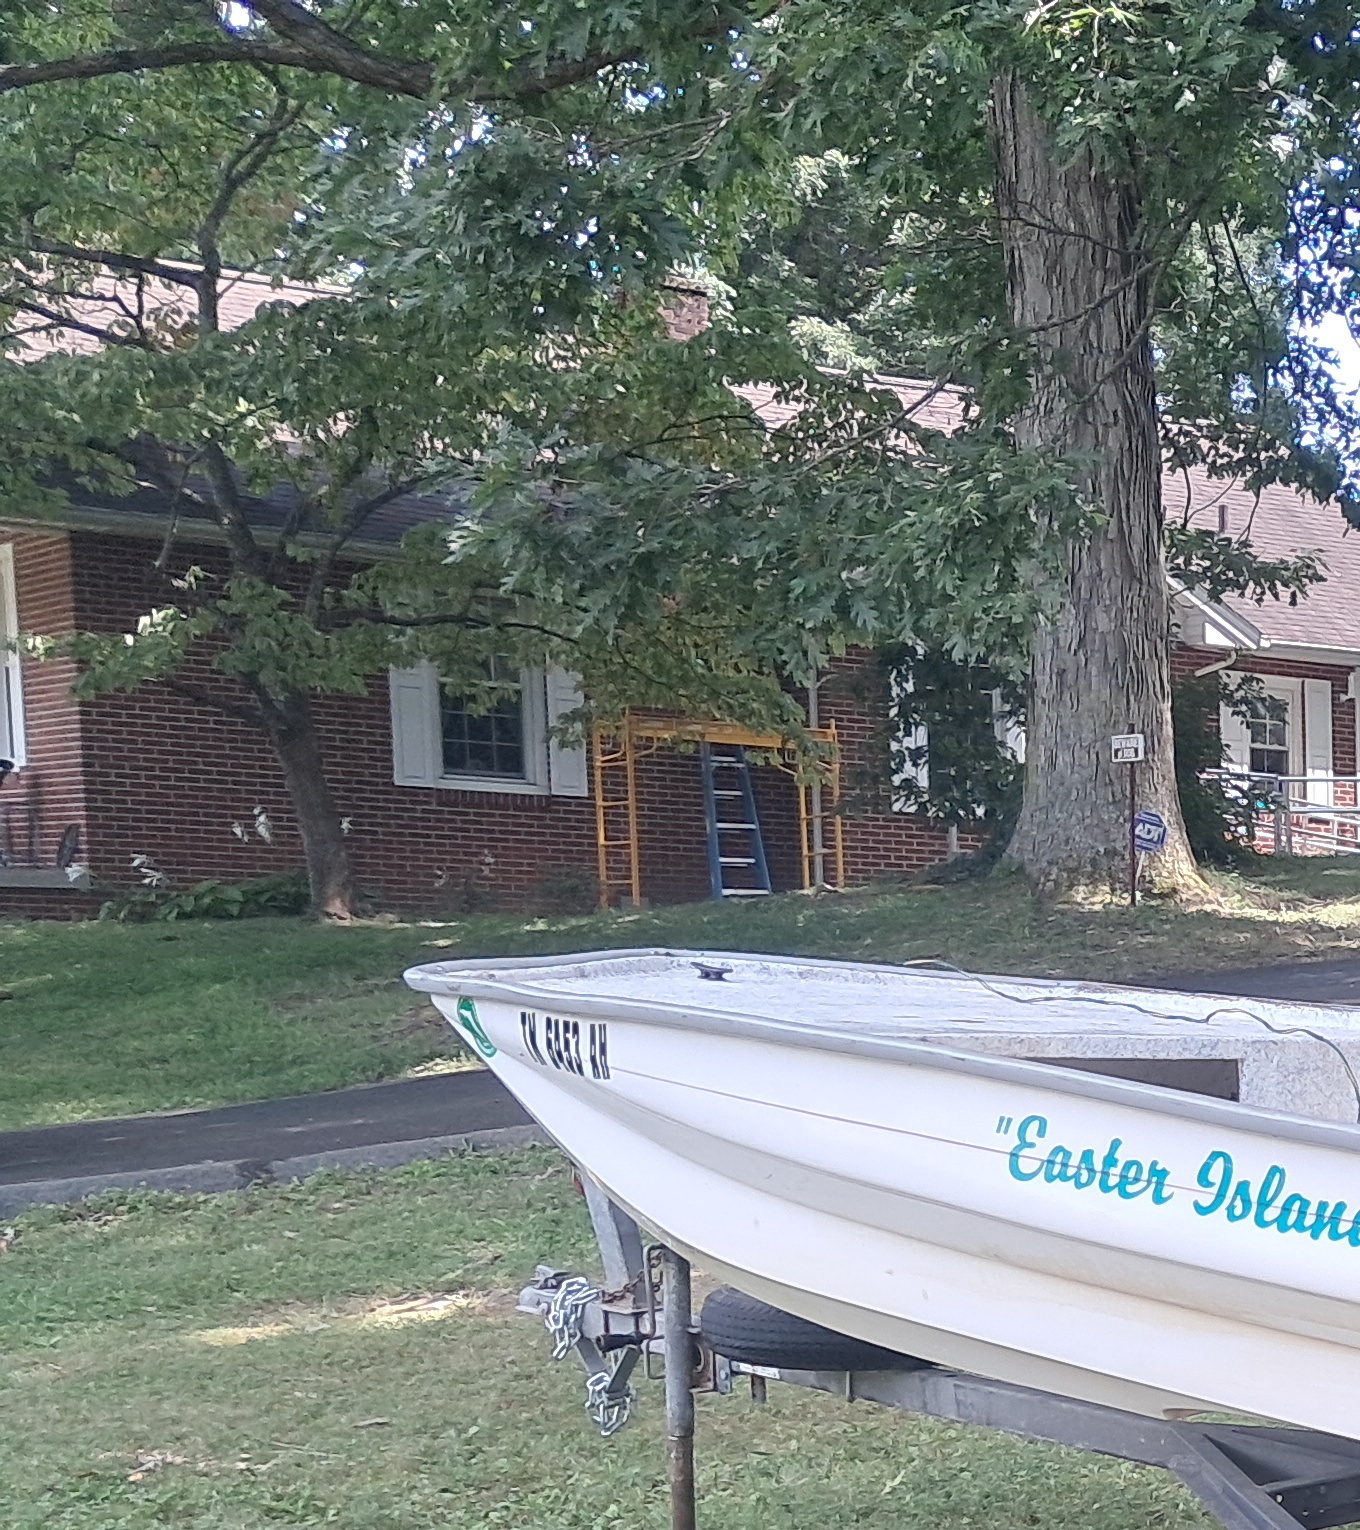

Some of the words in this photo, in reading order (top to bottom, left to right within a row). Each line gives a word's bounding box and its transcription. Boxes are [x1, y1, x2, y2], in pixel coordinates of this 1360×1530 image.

[520, 1011, 547, 1065] TN
[545, 1016, 584, 1076] 6453
[589, 1023, 610, 1079] AH
